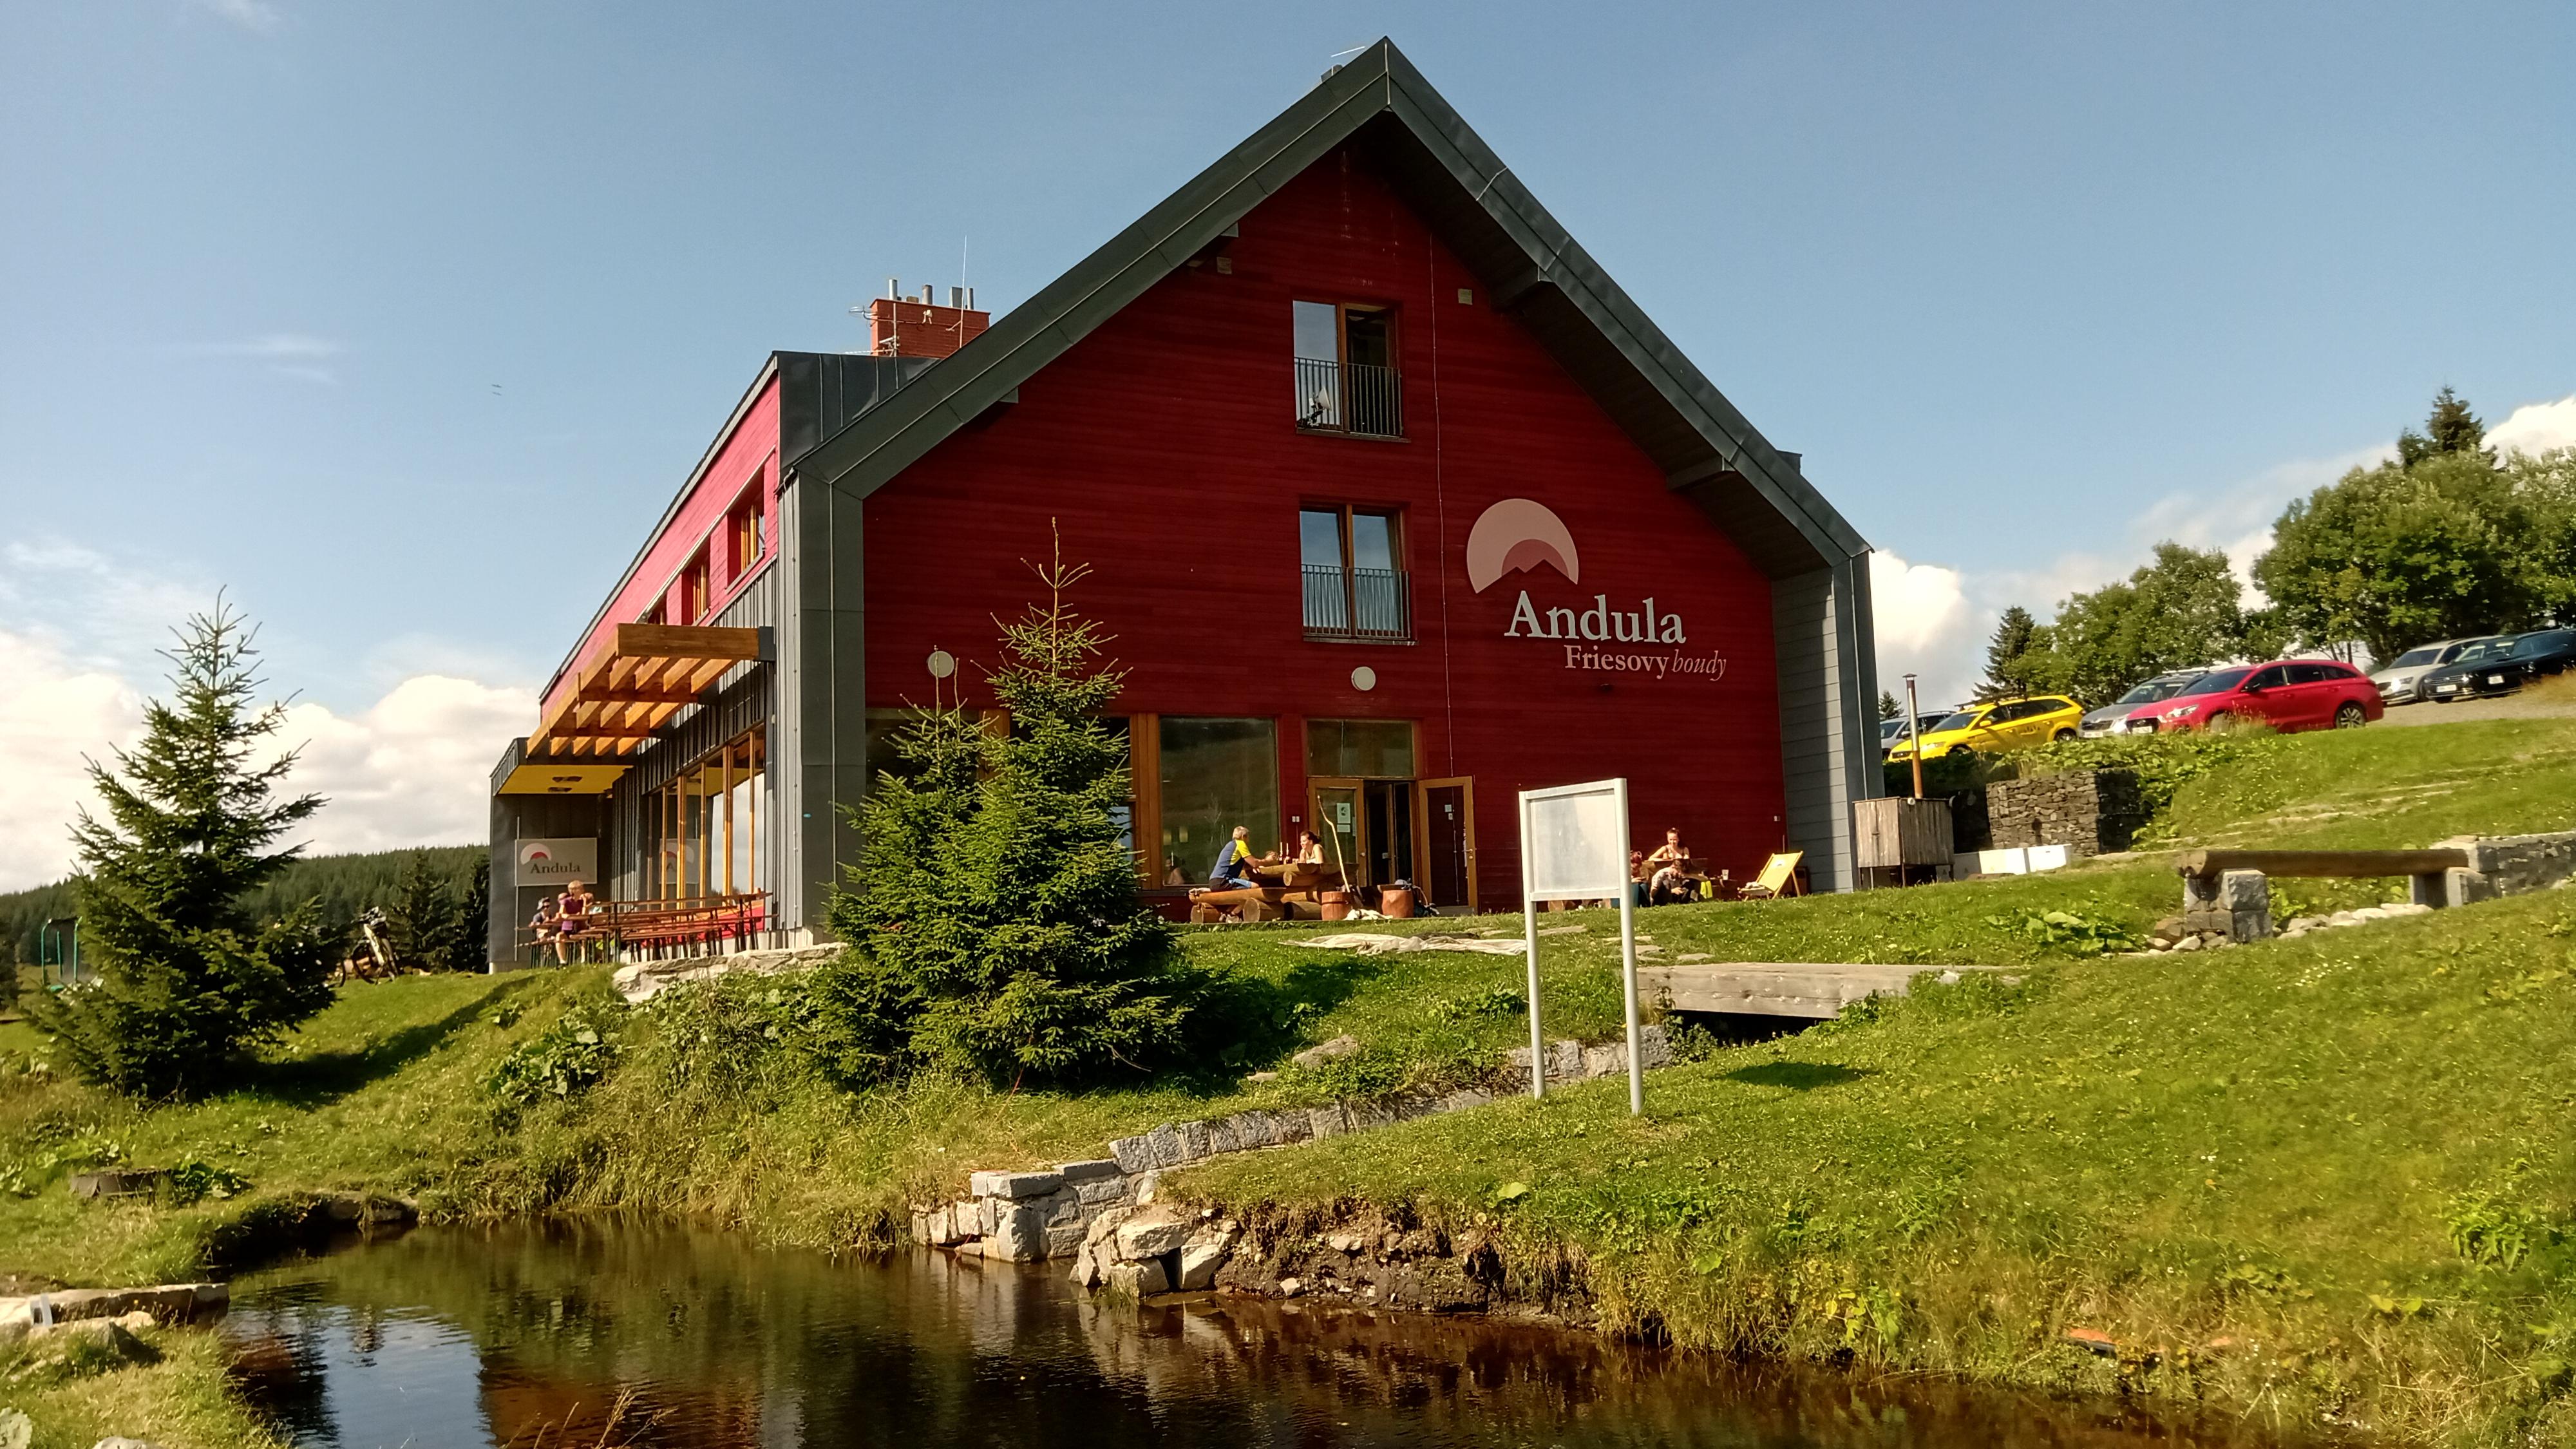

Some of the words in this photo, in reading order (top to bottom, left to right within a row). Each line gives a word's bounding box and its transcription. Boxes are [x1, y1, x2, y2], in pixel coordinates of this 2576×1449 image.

[1504, 591, 1687, 644] Andula
[1564, 645, 1670, 679] Friesovy
[1672, 649, 1727, 681] boudy
[530, 862, 581, 873] Andula
